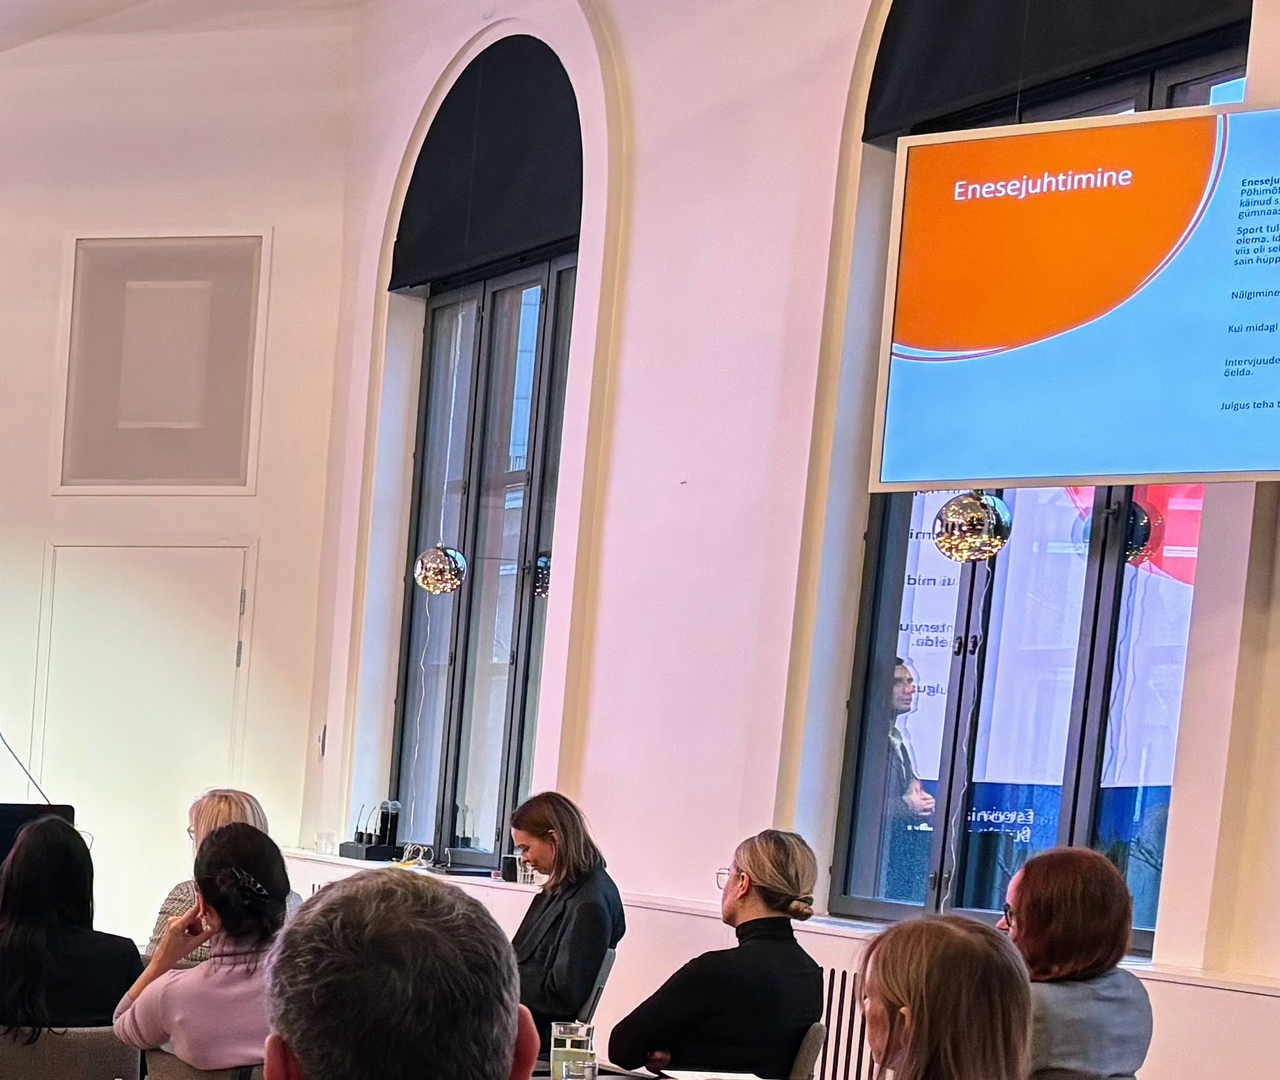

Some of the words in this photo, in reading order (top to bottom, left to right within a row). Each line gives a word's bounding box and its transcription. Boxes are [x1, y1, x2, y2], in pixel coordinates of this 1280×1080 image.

[953, 167, 1133, 201] Enesejuhtimine
[1239, 196, 1272, 207] käinud
[1228, 323, 1243, 333] Kui
[1245, 323, 1278, 333] midagi
[1220, 401, 1250, 412] Julgus
[1252, 400, 1274, 409] teha
